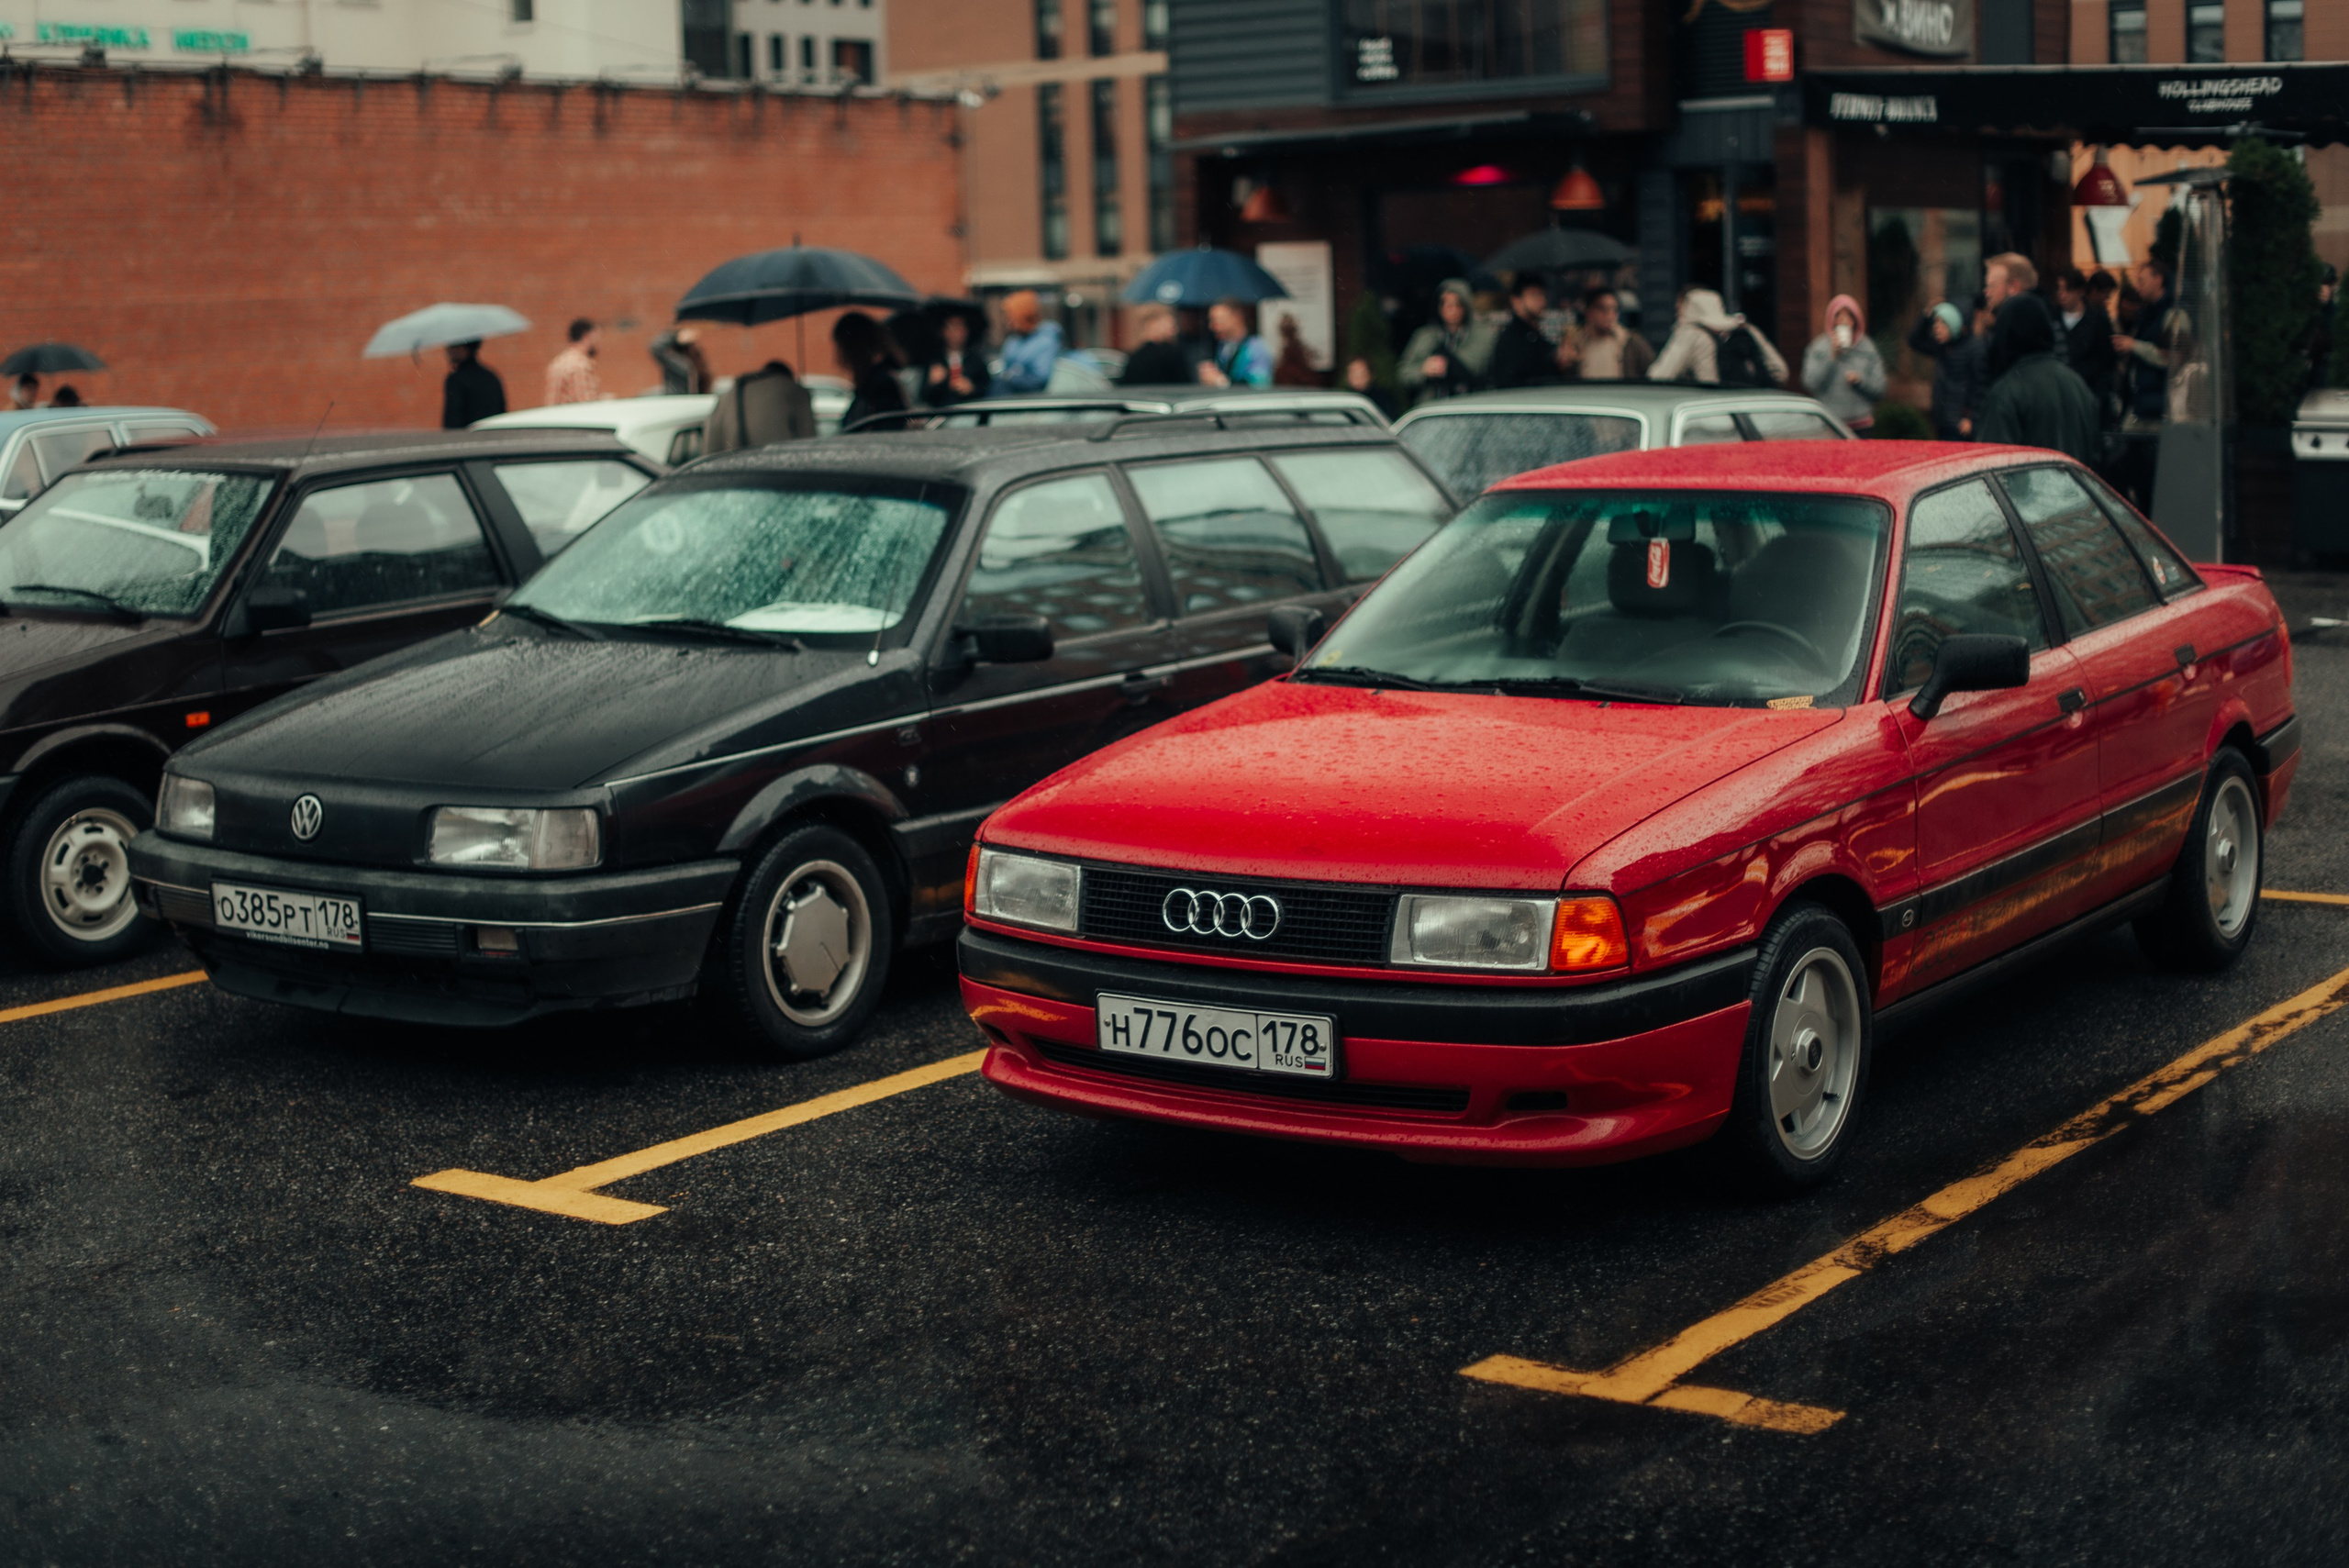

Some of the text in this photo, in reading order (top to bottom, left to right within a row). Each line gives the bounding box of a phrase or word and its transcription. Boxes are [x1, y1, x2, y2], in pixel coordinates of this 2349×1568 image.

[2158, 77, 2283, 99] HOLLINGSHEAD
[327, 926, 346, 940] RUS
[1275, 1054, 1303, 1068] RUS
